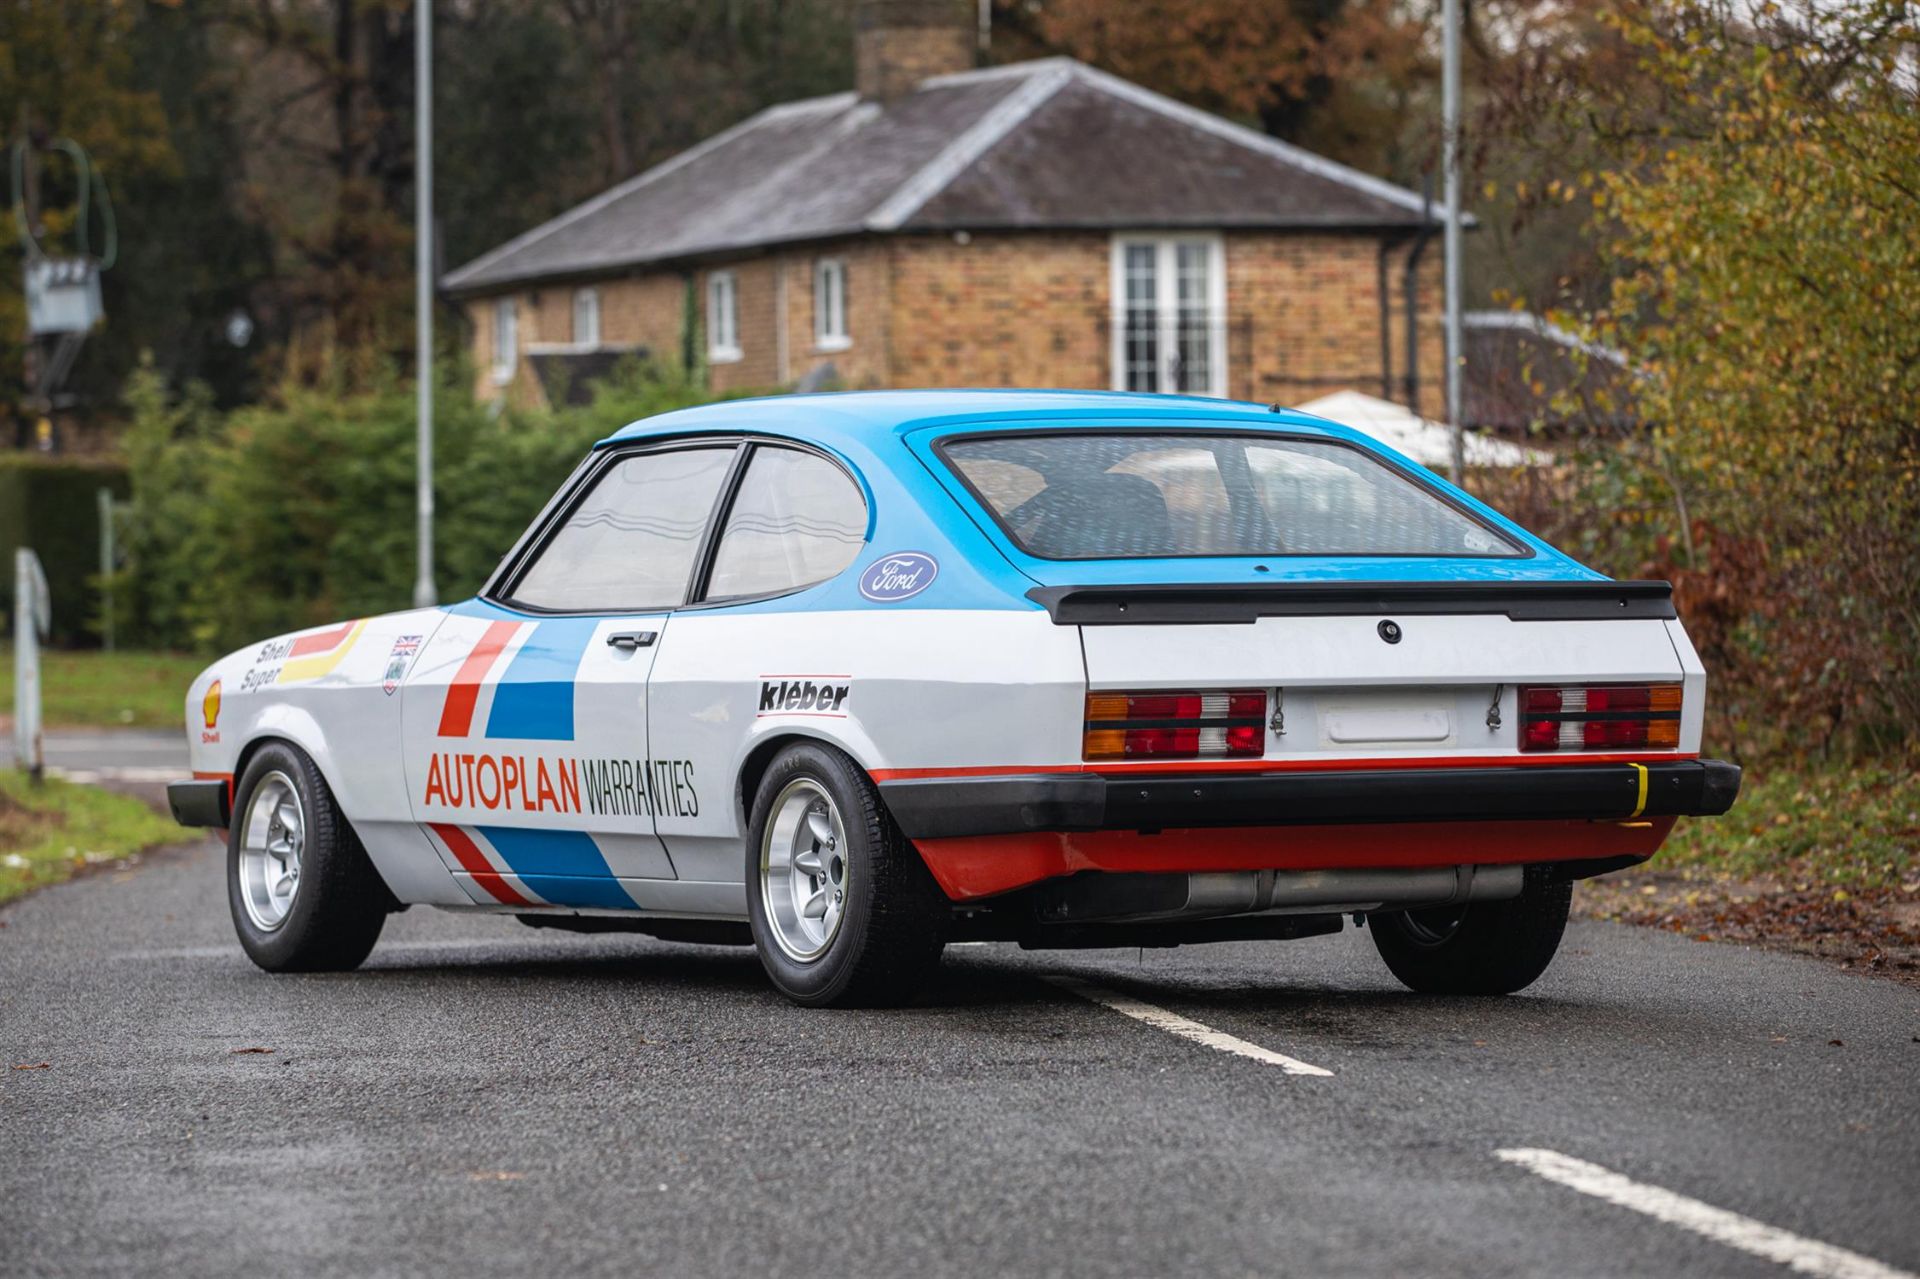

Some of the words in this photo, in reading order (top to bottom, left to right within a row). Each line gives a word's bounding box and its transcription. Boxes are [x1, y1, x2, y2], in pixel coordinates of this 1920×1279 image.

[872, 558, 923, 591] Ford
[256, 638, 296, 663] Shell
[241, 668, 282, 693] Super
[759, 681, 849, 711] kléber
[202, 731, 220, 744] Shell
[425, 753, 581, 813] AUTOPLAN
[582, 759, 698, 817] WARRANTIES
